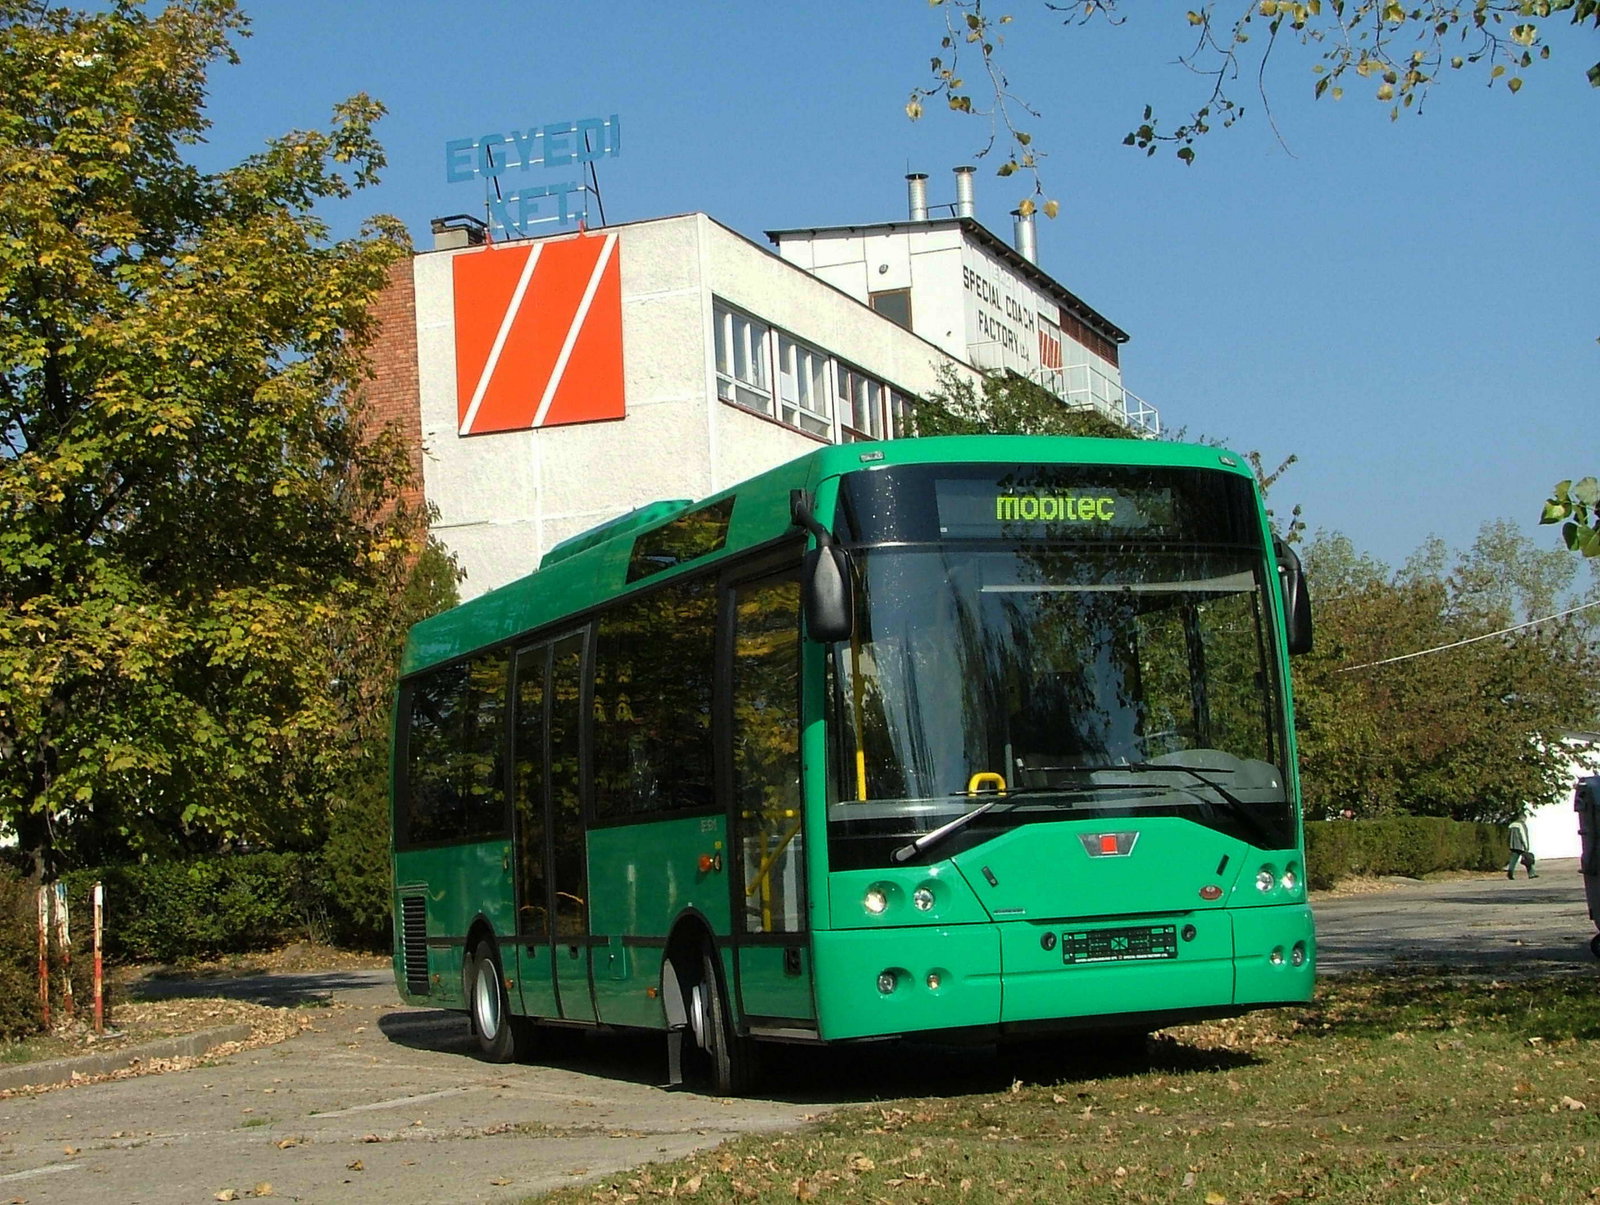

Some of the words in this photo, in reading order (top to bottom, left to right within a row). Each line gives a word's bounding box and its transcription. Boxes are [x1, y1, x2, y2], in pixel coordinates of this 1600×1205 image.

[446, 114, 620, 183] EGYEDI
[963, 265, 1002, 312] SPECIAL
[1006, 295, 1034, 333] COACH
[978, 309, 1018, 354] FACTORY
[996, 493, 1115, 520] mobitec
